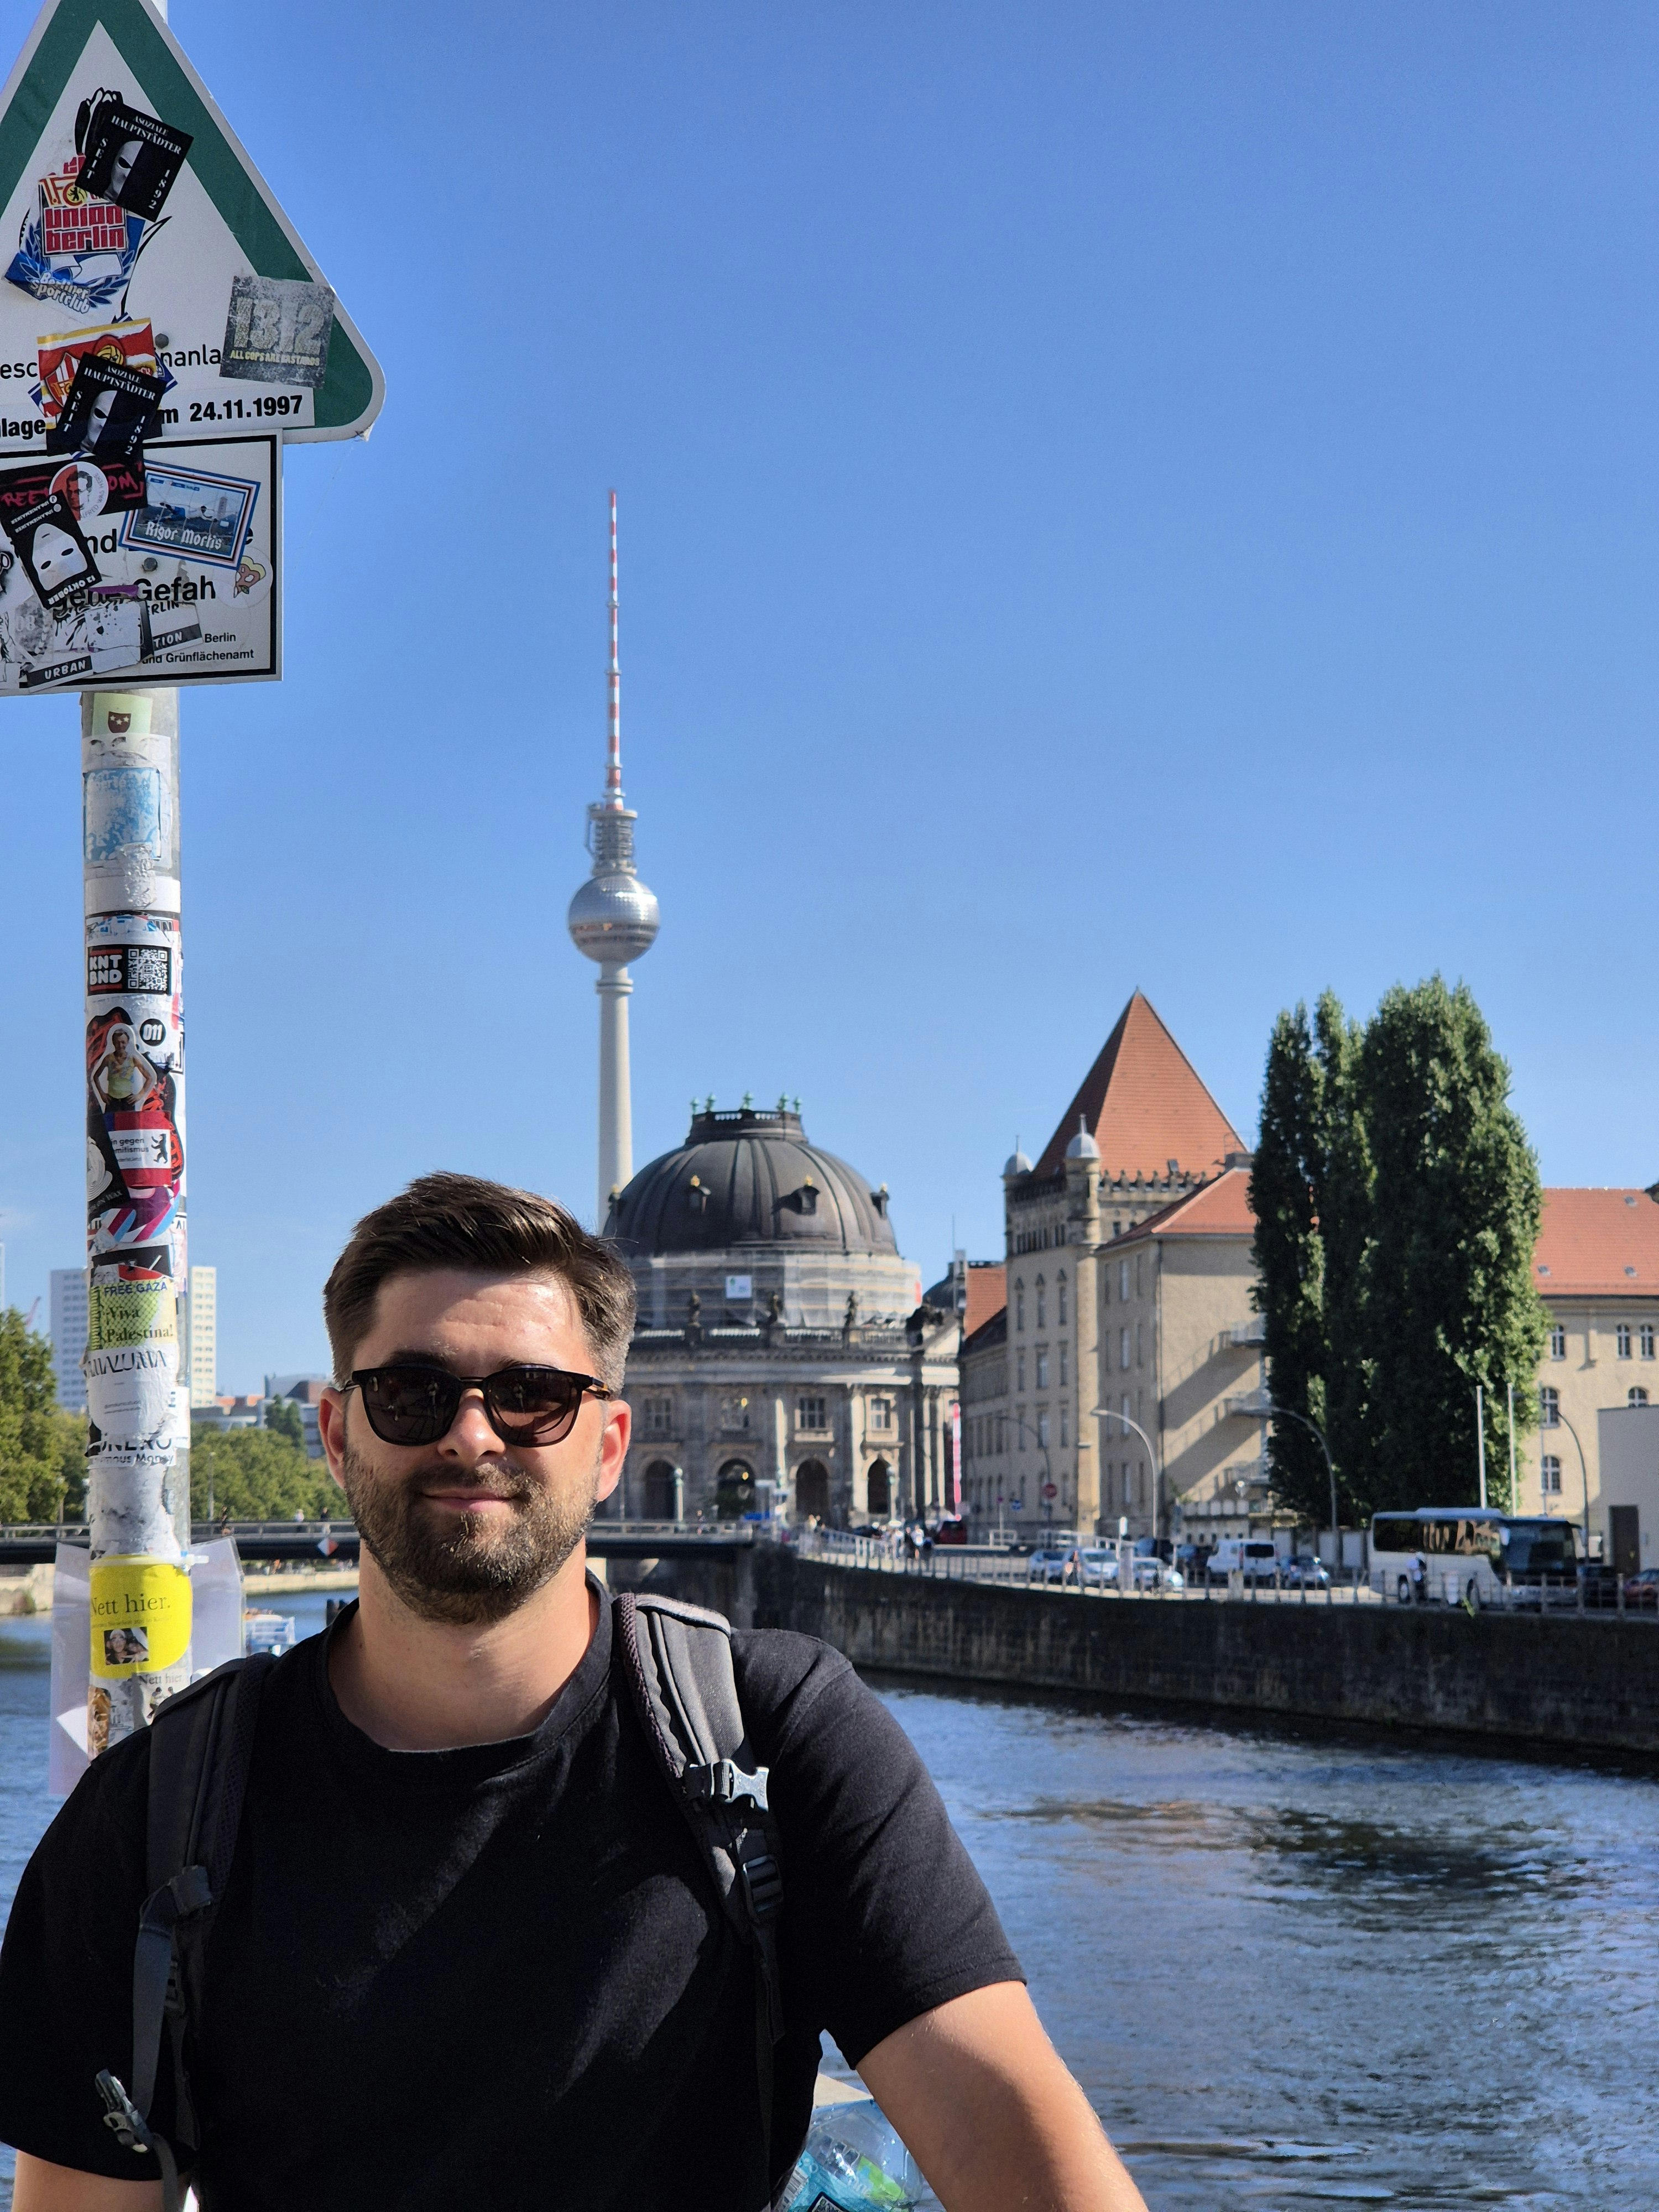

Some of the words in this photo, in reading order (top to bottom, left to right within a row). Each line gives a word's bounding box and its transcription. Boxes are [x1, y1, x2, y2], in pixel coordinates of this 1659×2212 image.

[111, 115, 182, 155] HAUPTSTÄDTER
[132, 115, 169, 137] ASOZIALE
[86, 138, 108, 179] SEIT
[148, 169, 171, 210] 1892
[45, 225, 126, 253] berlin
[234, 296, 324, 356] 1312
[230, 349, 244, 360] ALL
[245, 351, 265, 362] COPS
[84, 367, 156, 401] HAUPTSTÄDTER
[105, 365, 142, 384] ASOZIALE
[62, 390, 83, 432] SEIT
[190, 395, 303, 422] 24.11.1997
[124, 415, 146, 455] 1892
[145, 521, 178, 541] Rigor
[181, 528, 222, 550] Mortis
[48, 580, 86, 606] OKTOBER
[204, 632, 237, 643] Berlin
[165, 649, 254, 663] Grünflächenamt
[44, 660, 86, 680] URBAN
[90, 954, 123, 971] KNT
[90, 969, 123, 985] BND
[143, 1024, 163, 1041] 011
[119, 1138, 145, 1146] gegen
[104, 1284, 133, 1296] FREE
[135, 1281, 168, 1293] GAZA
[106, 1324, 174, 1343] Palestina!
[124, 1593, 171, 1613] hier.
